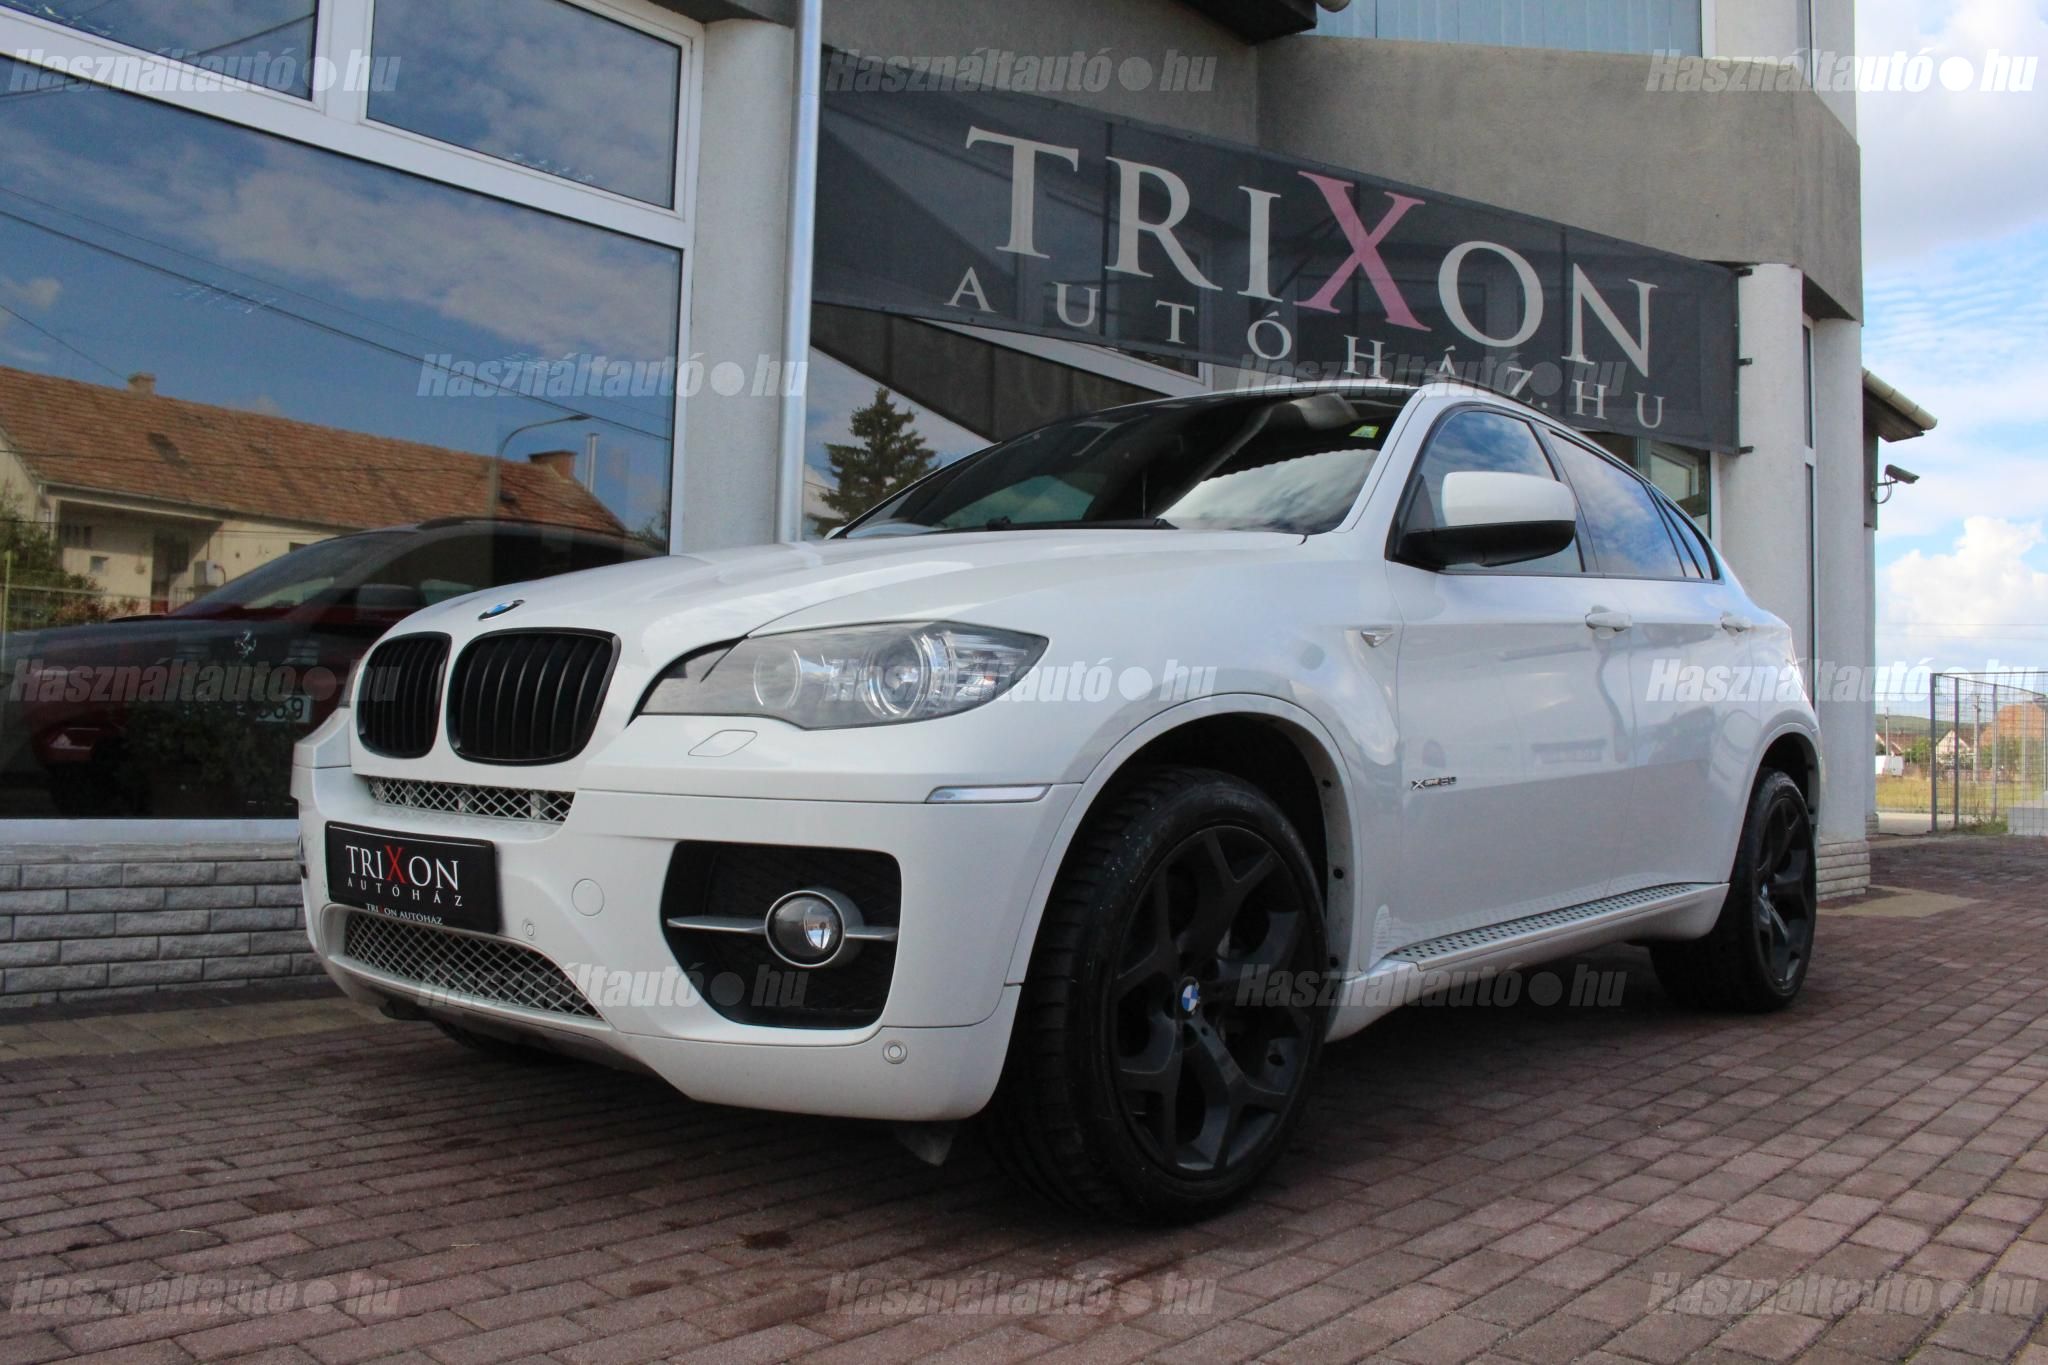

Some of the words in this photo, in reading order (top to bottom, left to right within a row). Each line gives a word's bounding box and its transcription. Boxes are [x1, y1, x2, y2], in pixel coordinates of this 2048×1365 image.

[965, 125, 1659, 378] TRIXON
[345, 845, 459, 891] TRIXON
[348, 877, 463, 907] AUTÓHÁZ
